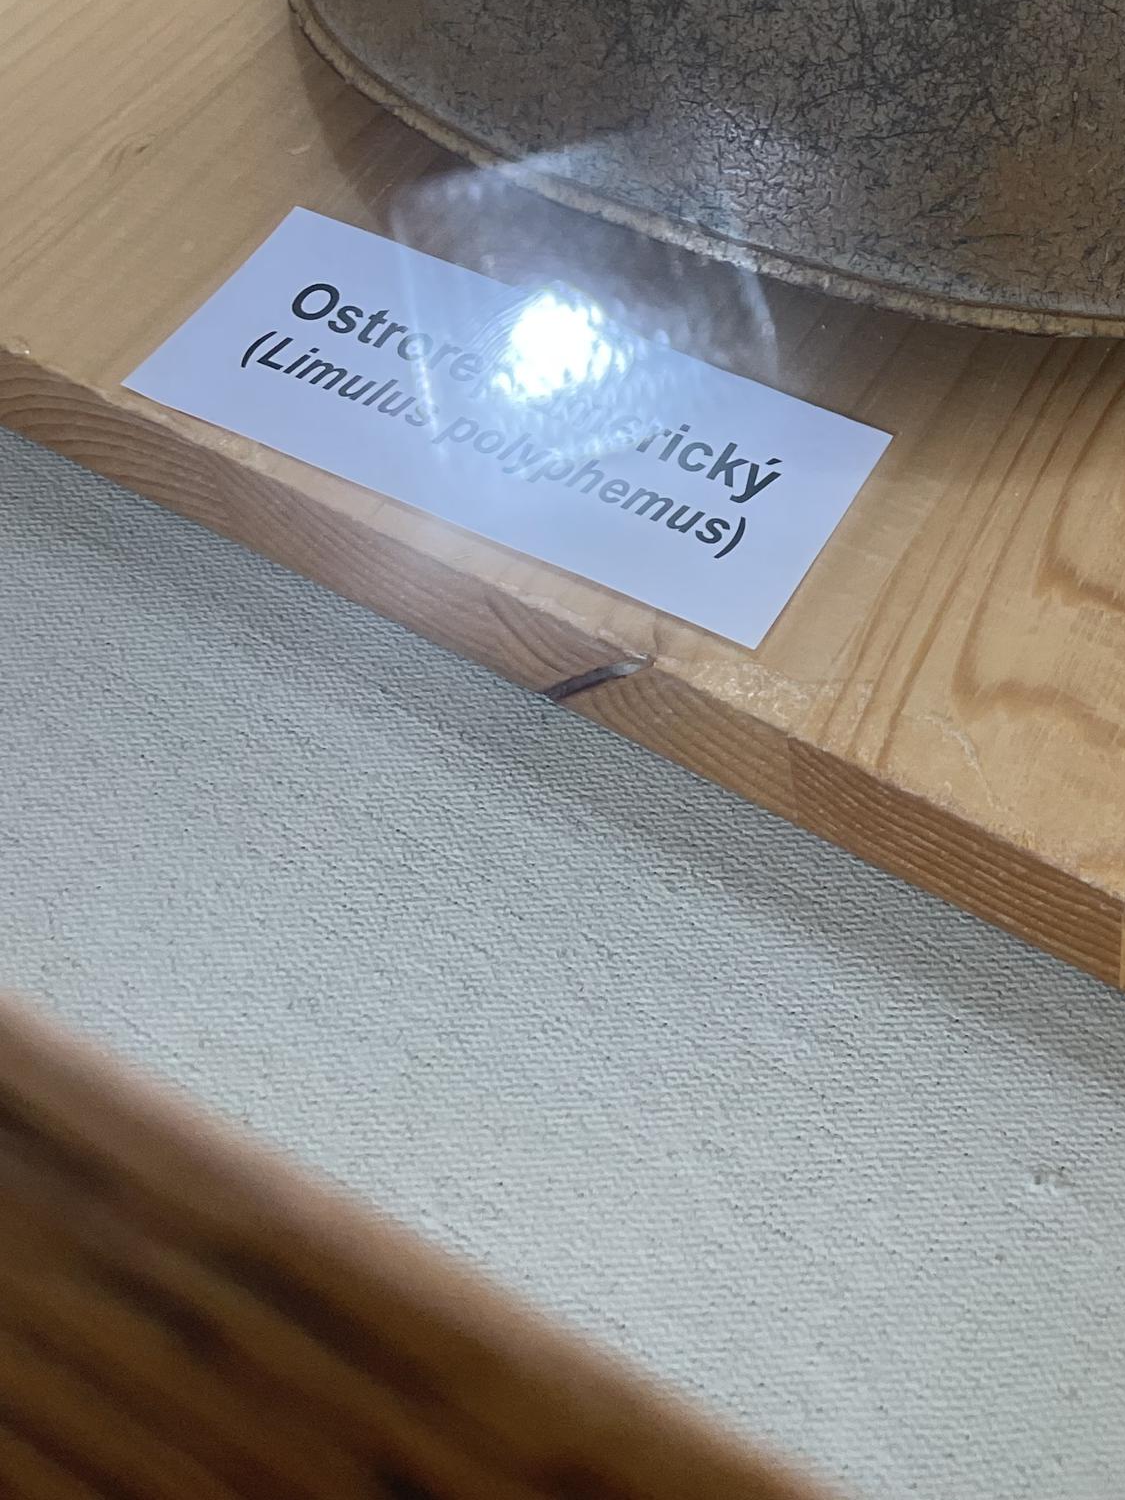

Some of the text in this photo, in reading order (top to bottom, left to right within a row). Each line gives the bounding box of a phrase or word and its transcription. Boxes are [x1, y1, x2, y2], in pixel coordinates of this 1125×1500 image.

[291, 283, 506, 398] Ostrore
[240, 331, 746, 559] (Limulus polyphemus)
